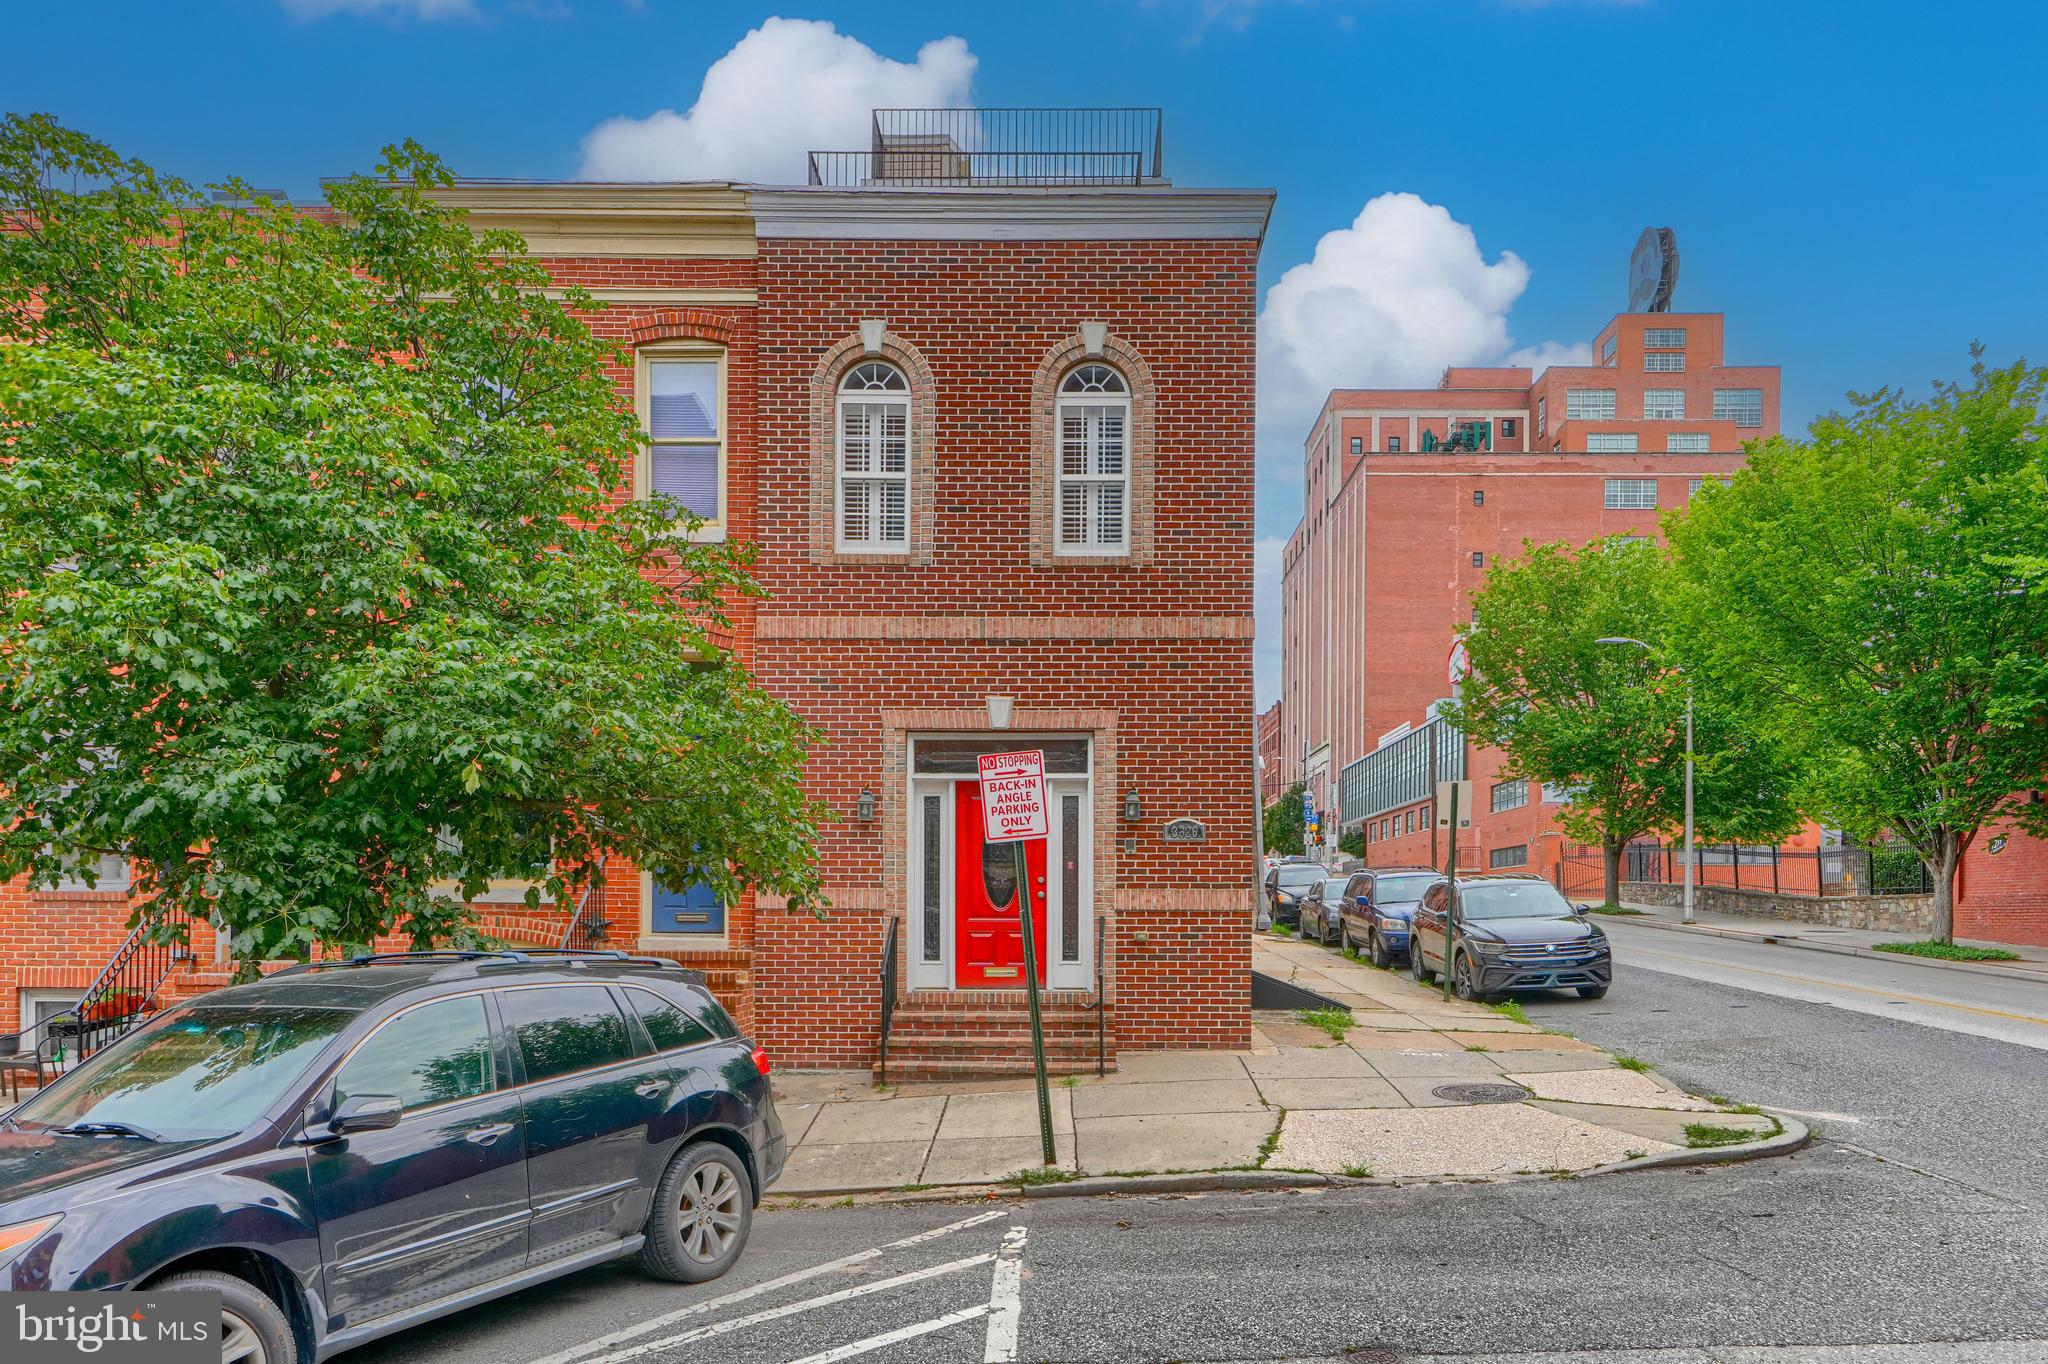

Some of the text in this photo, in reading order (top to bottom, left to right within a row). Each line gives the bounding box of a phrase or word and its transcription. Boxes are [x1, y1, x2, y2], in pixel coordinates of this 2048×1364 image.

[981, 754, 1039, 769] NO STOPPING
[989, 779, 1036, 792] BACK-IN
[997, 791, 1032, 804] ANGLE
[991, 803, 1039, 816] PARKING
[1001, 815, 1032, 827] ONLY
